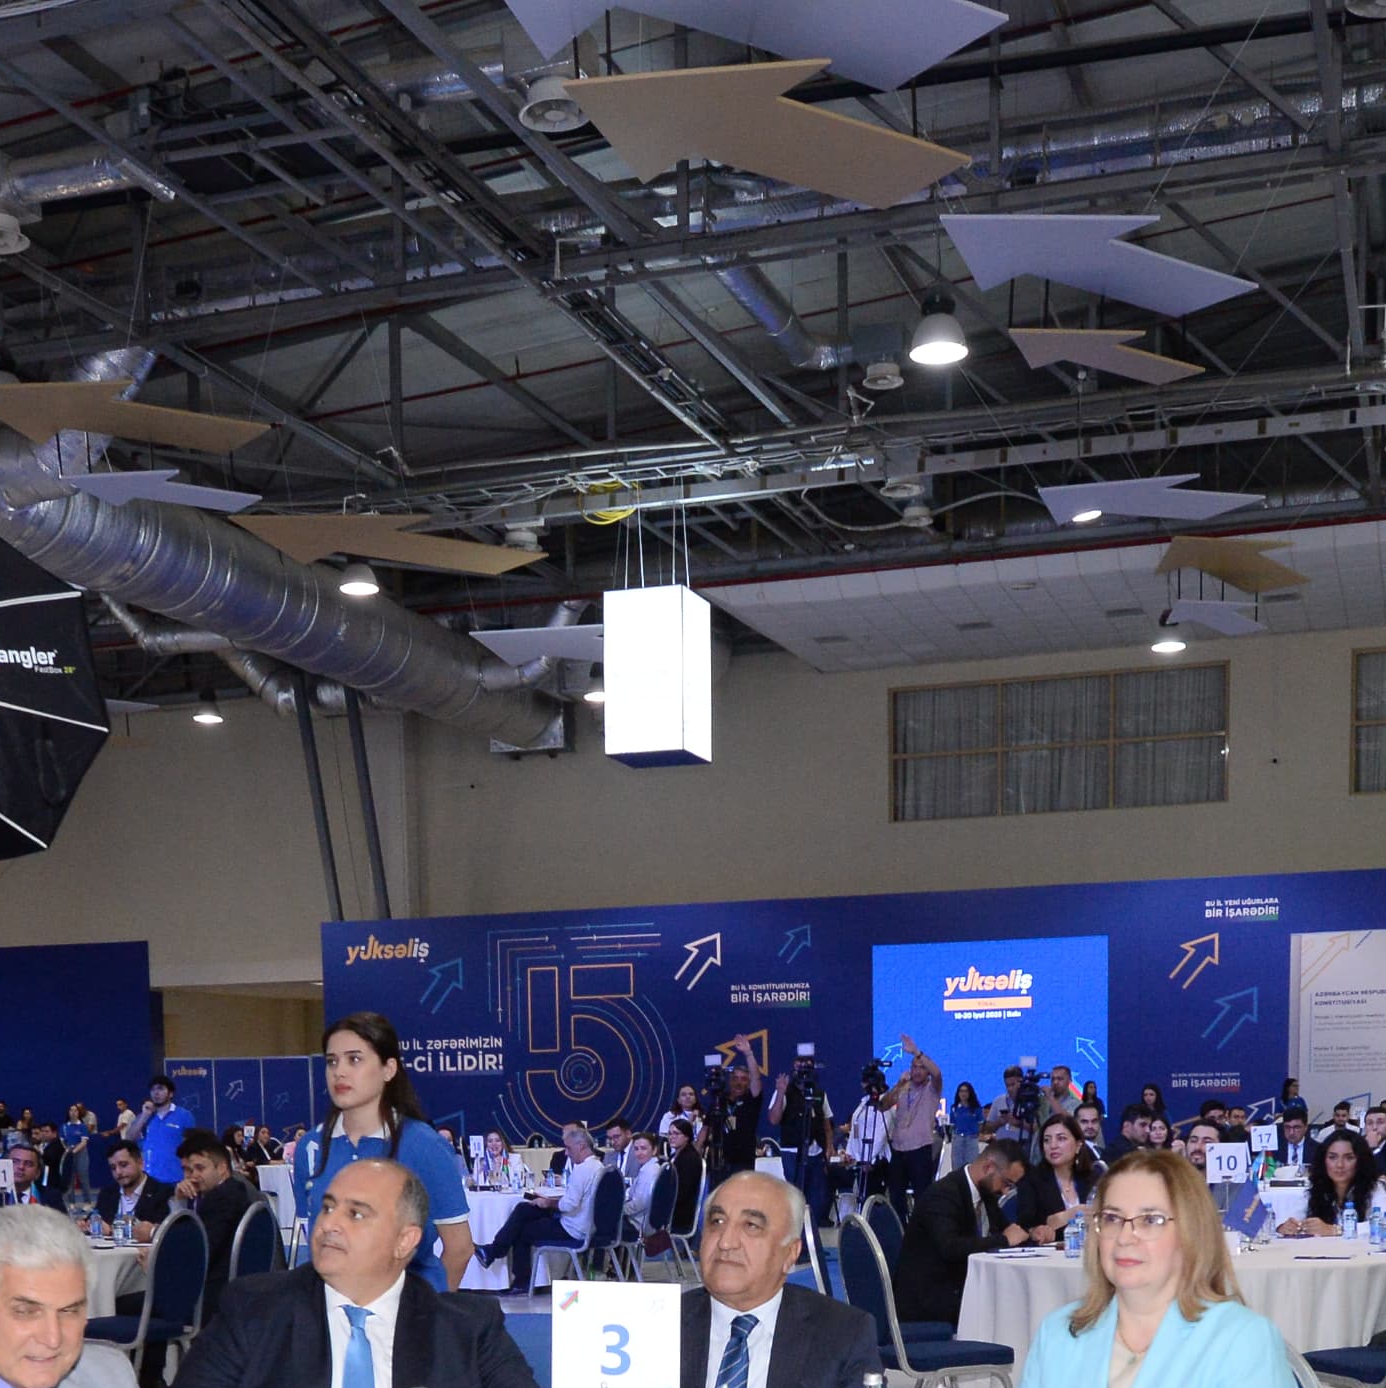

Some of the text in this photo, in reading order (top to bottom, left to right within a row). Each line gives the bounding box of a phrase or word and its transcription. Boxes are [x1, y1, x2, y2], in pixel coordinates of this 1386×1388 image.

[1205, 905, 1280, 918] BİR İŞARƏDİR!
[345, 934, 430, 965] yüksəliş
[943, 966, 1033, 997] yüksəliş
[731, 990, 811, 1004] BİR İŞARƏDİR!
[413, 1038, 423, 1050] İL
[426, 1035, 502, 1050] ZƏFƏRİMİZİN
[403, 1051, 504, 1072] -Cİ İLİDİR!
[1258, 1133, 1272, 1143] 17
[1215, 1155, 1238, 1171] 10
[600, 1323, 631, 1376] 3
